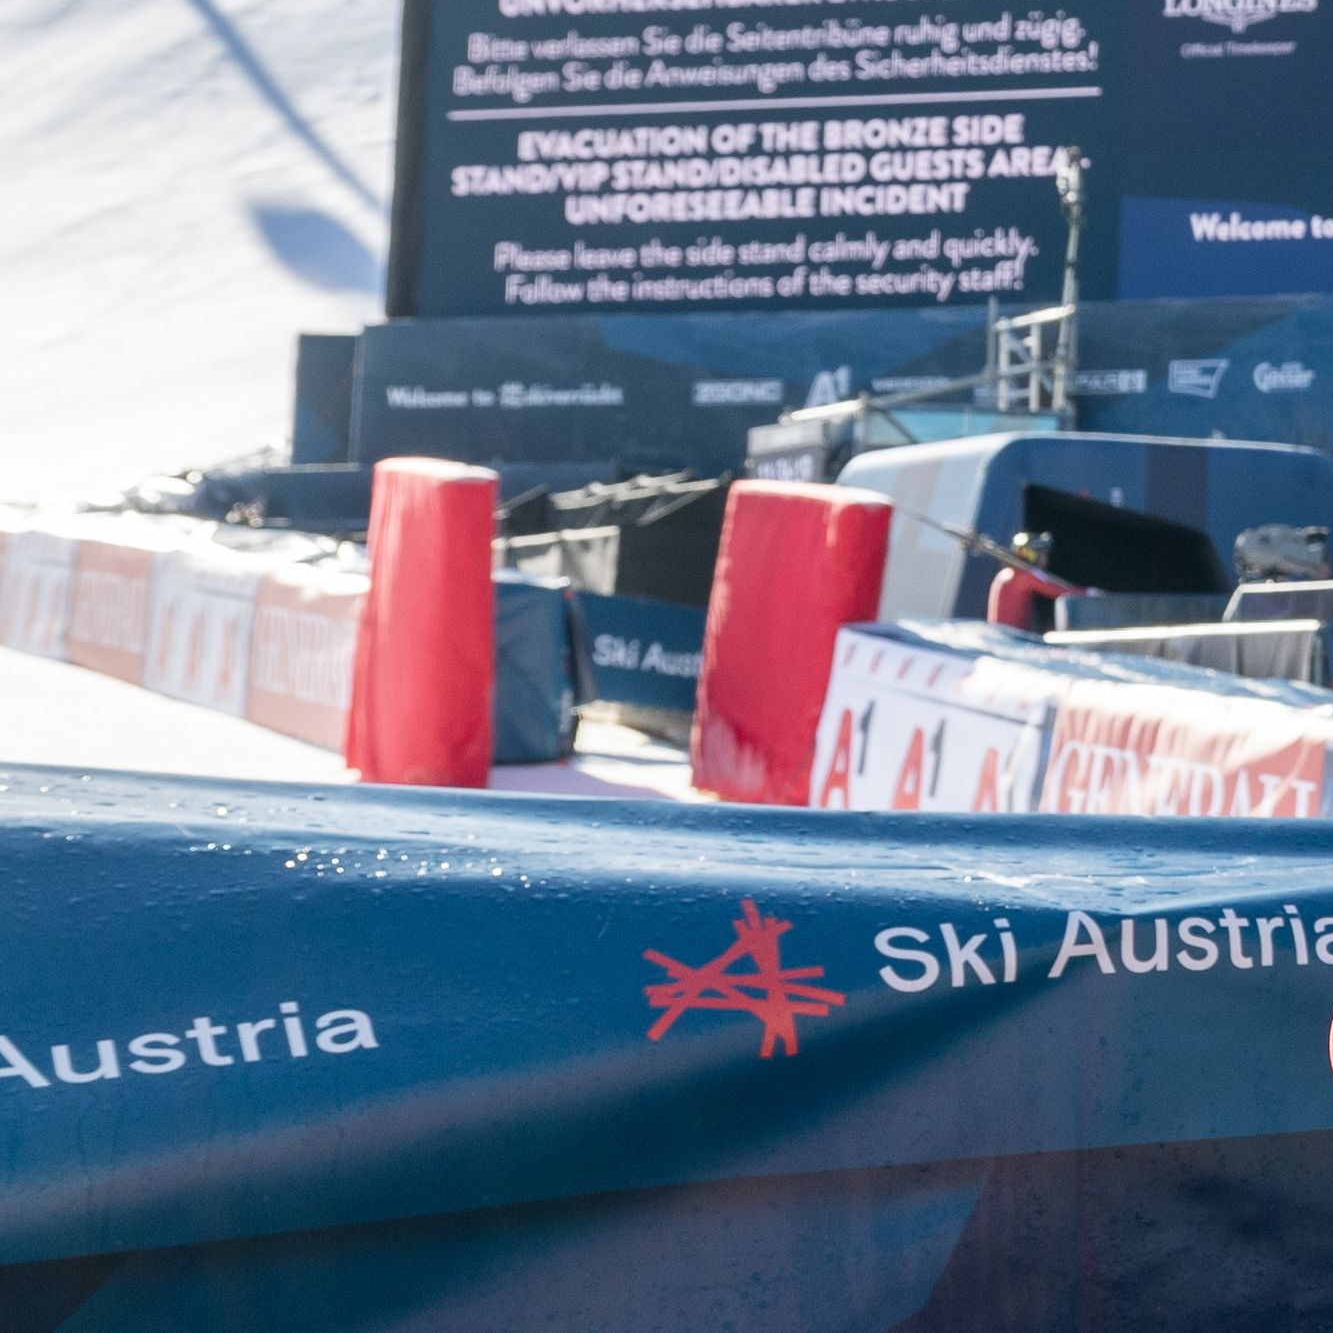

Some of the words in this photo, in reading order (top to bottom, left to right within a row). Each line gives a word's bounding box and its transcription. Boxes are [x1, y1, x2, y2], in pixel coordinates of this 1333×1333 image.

[467, 32, 529, 63] Bitte
[530, 29, 640, 60] verlassen
[641, 25, 682, 56] Sie
[684, 24, 724, 55] die
[726, 18, 892, 52] Seitentribüne
[893, 14, 960, 54] ruhig
[962, 11, 1011, 43] und
[453, 64, 560, 103] Befolgen
[561, 61, 602, 92] Sie
[603, 59, 644, 90] die
[644, 55, 804, 94] Anweisungen
[808, 51, 851, 82] des
[854, 40, 1099, 81] Sicherheitsdienstes!
[517, 124, 708, 161] EVACUATION
[711, 123, 756, 155] OF
[758, 121, 820, 153] THE
[823, 116, 948, 150] BRONZE
[952, 113, 1025, 146] SIDE
[451, 161, 610, 196] STAND/VIP
[611, 152, 866, 191] STAND/DISABLED
[869, 148, 985, 182] GUESTS
[565, 187, 815, 225] UNFORESEEABLE
[820, 182, 970, 216] INCIDENT
[1190, 212, 1306, 242] Welcome
[494, 241, 572, 272] Please
[573, 239, 637, 268] leave
[639, 237, 682, 267] the
[684, 236, 736, 266] side
[737, 233, 806, 265] stand
[808, 230, 891, 270] calmly
[892, 228, 941, 260] and
[504, 273, 584, 305] Follow
[586, 272, 630, 303] the
[632, 268, 774, 300] instructions
[776, 265, 808, 297] of
[809, 265, 853, 295] the
[855, 264, 956, 302] security
[958, 260, 1024, 292] staff!
[874, 916, 1019, 993] Ski
